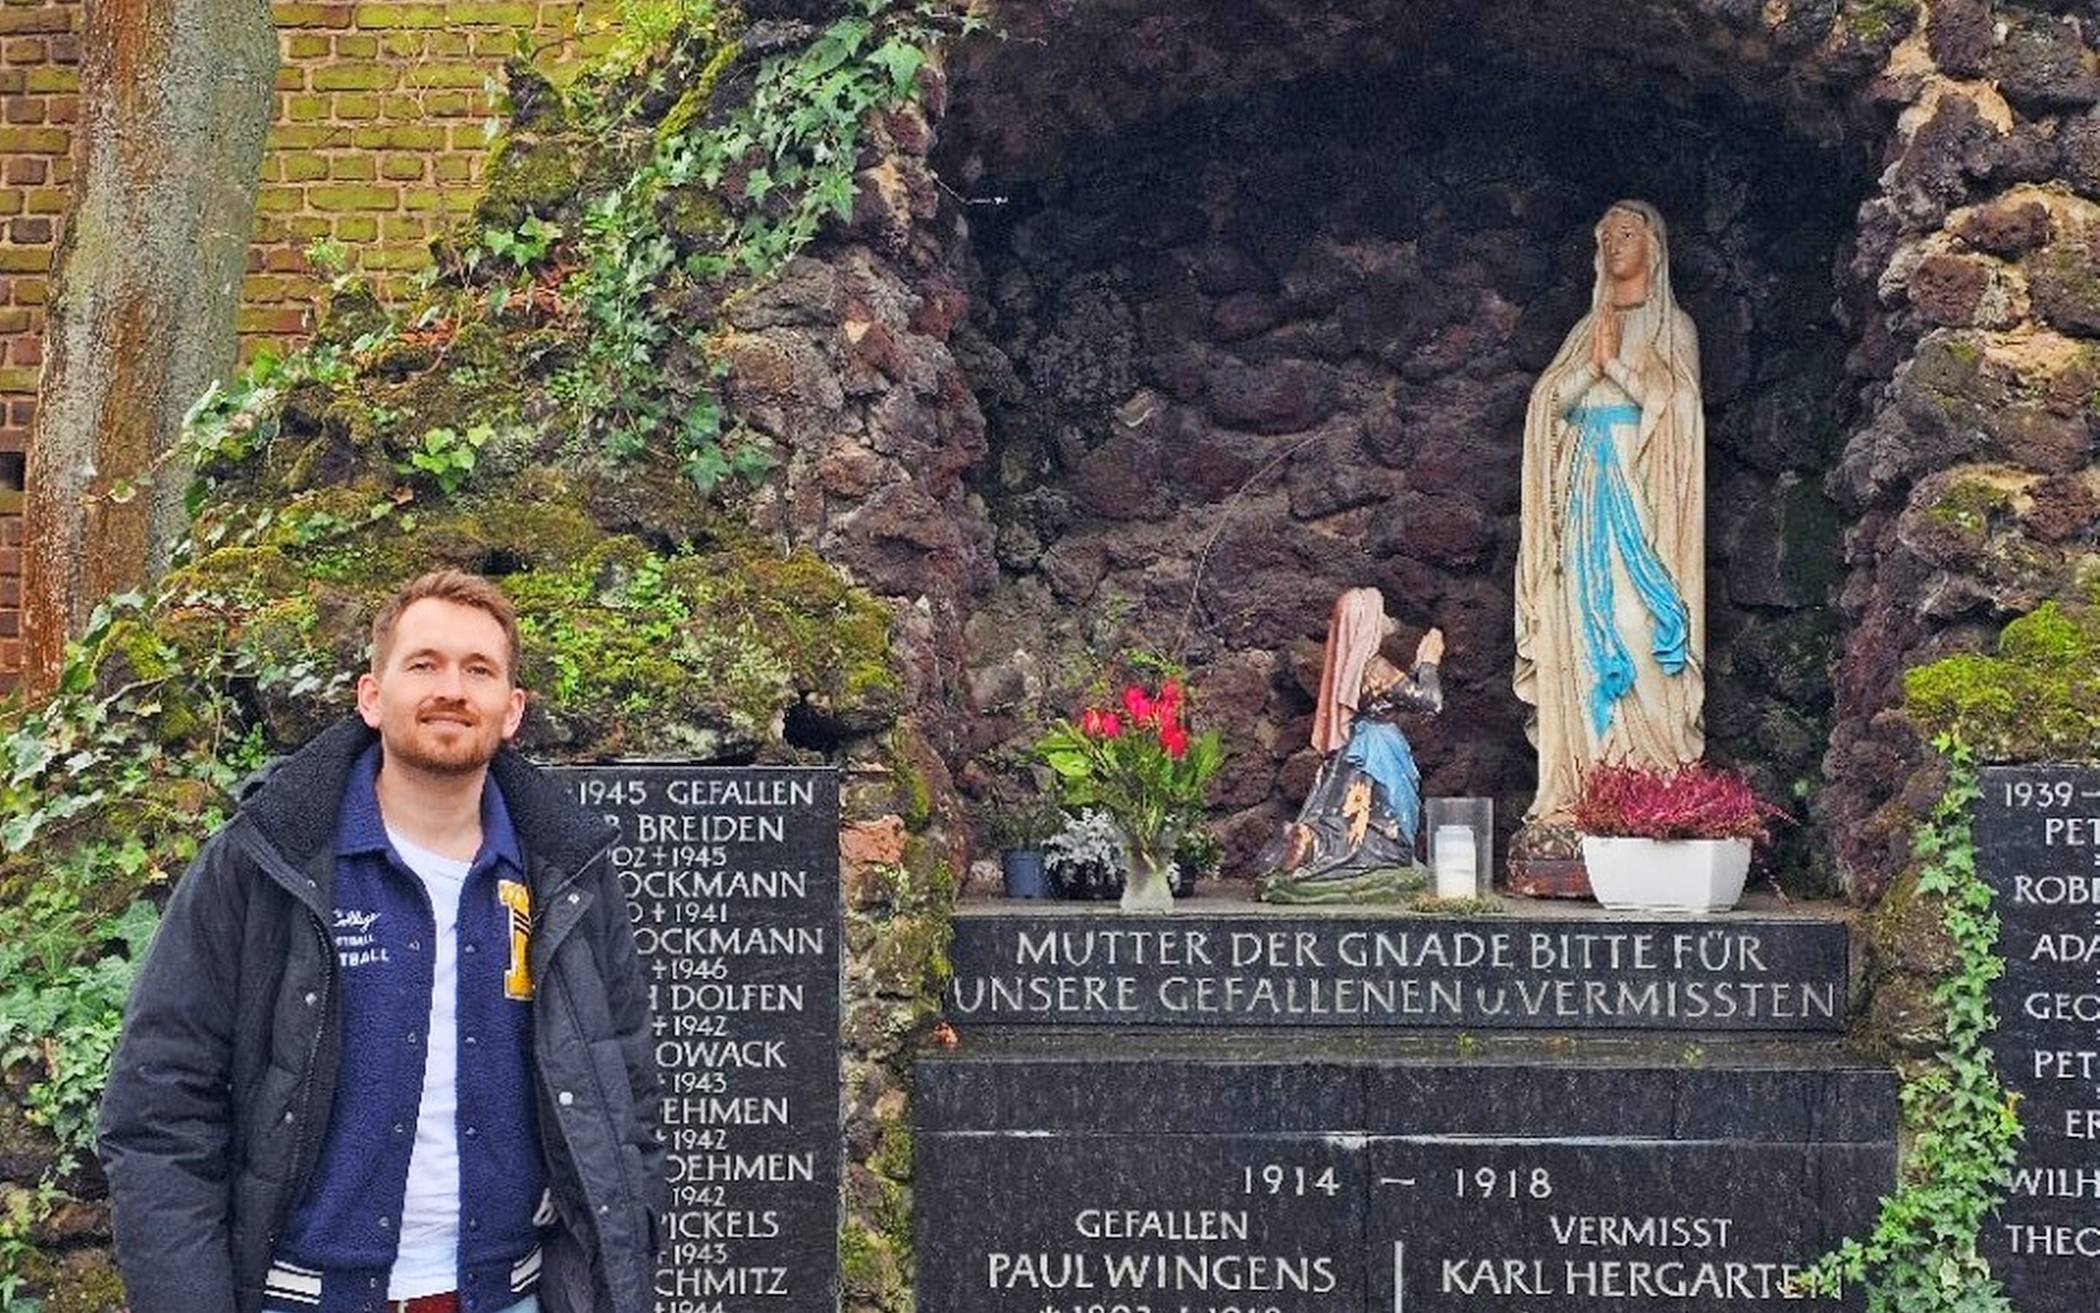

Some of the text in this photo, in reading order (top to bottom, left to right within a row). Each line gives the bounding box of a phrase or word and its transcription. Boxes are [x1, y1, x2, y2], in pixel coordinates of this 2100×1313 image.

[579, 780, 814, 805] 1945 GEFALLEN
[2005, 782, 2074, 808] 1939
[637, 814, 784, 842] BREIDEN
[1016, 929, 1768, 972] MUTTER DER GNADE BITTE FÜR
[671, 984, 804, 1011] DOLFEN
[953, 975, 1140, 1014] UNSERE
[1157, 977, 1462, 1015] GEFALLENEN
[2034, 1050, 2098, 1080] PET
[659, 1098, 788, 1125] EHMEN
[672, 1186, 727, 1207] 1942
[1244, 1164, 1341, 1197] 1914
[1455, 1168, 1553, 1199] 1918
[661, 1211, 780, 1239] ICKELS
[1075, 1209, 1249, 1241] GEFALLEN
[1549, 1214, 1733, 1249] VERMISST
[987, 1253, 1337, 1294] PAUL WINGENS
[1441, 1258, 1553, 1297] KARL
